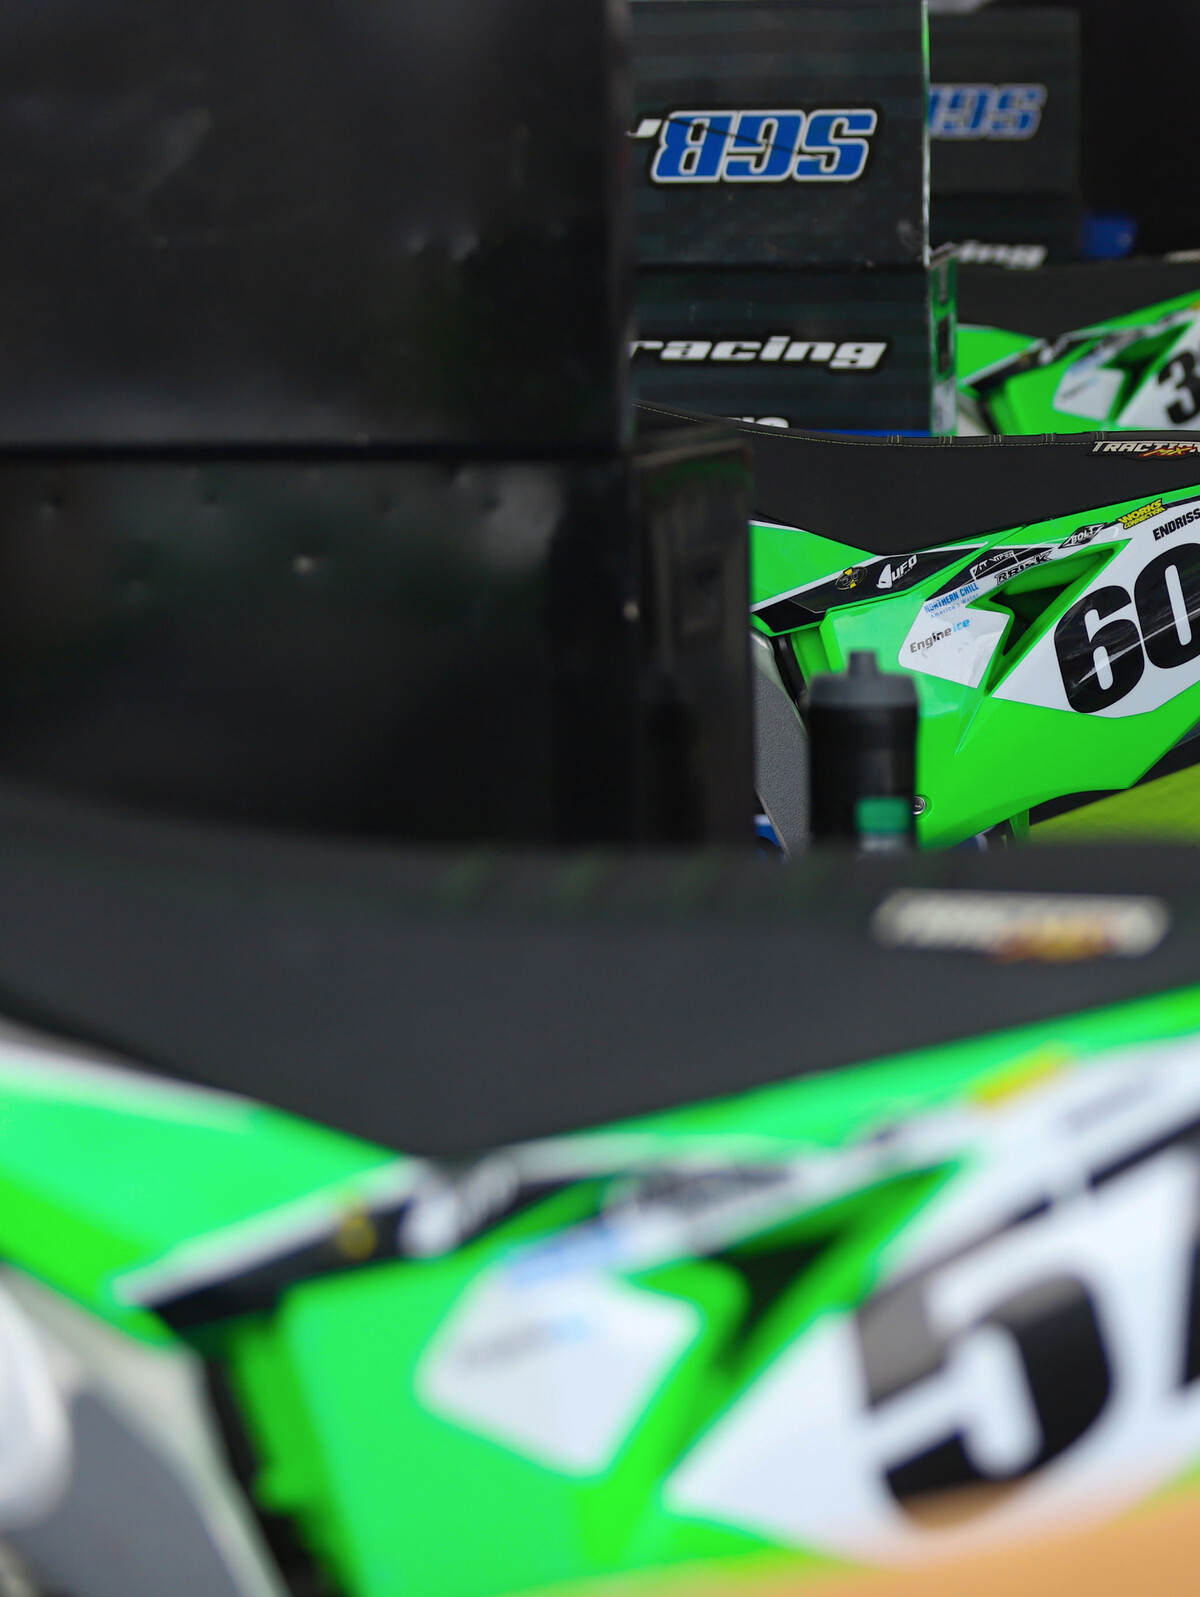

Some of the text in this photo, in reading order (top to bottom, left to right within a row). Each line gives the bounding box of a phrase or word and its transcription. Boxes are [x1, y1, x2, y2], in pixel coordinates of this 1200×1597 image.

[1118, 498, 1162, 525] WORKS
[1123, 506, 1167, 530] CONNECTION
[1071, 526, 1098, 544] BOLT
[891, 554, 918, 581] UFO
[924, 582, 979, 613] NORTHERN CHILL
[910, 627, 952, 653] Engine
